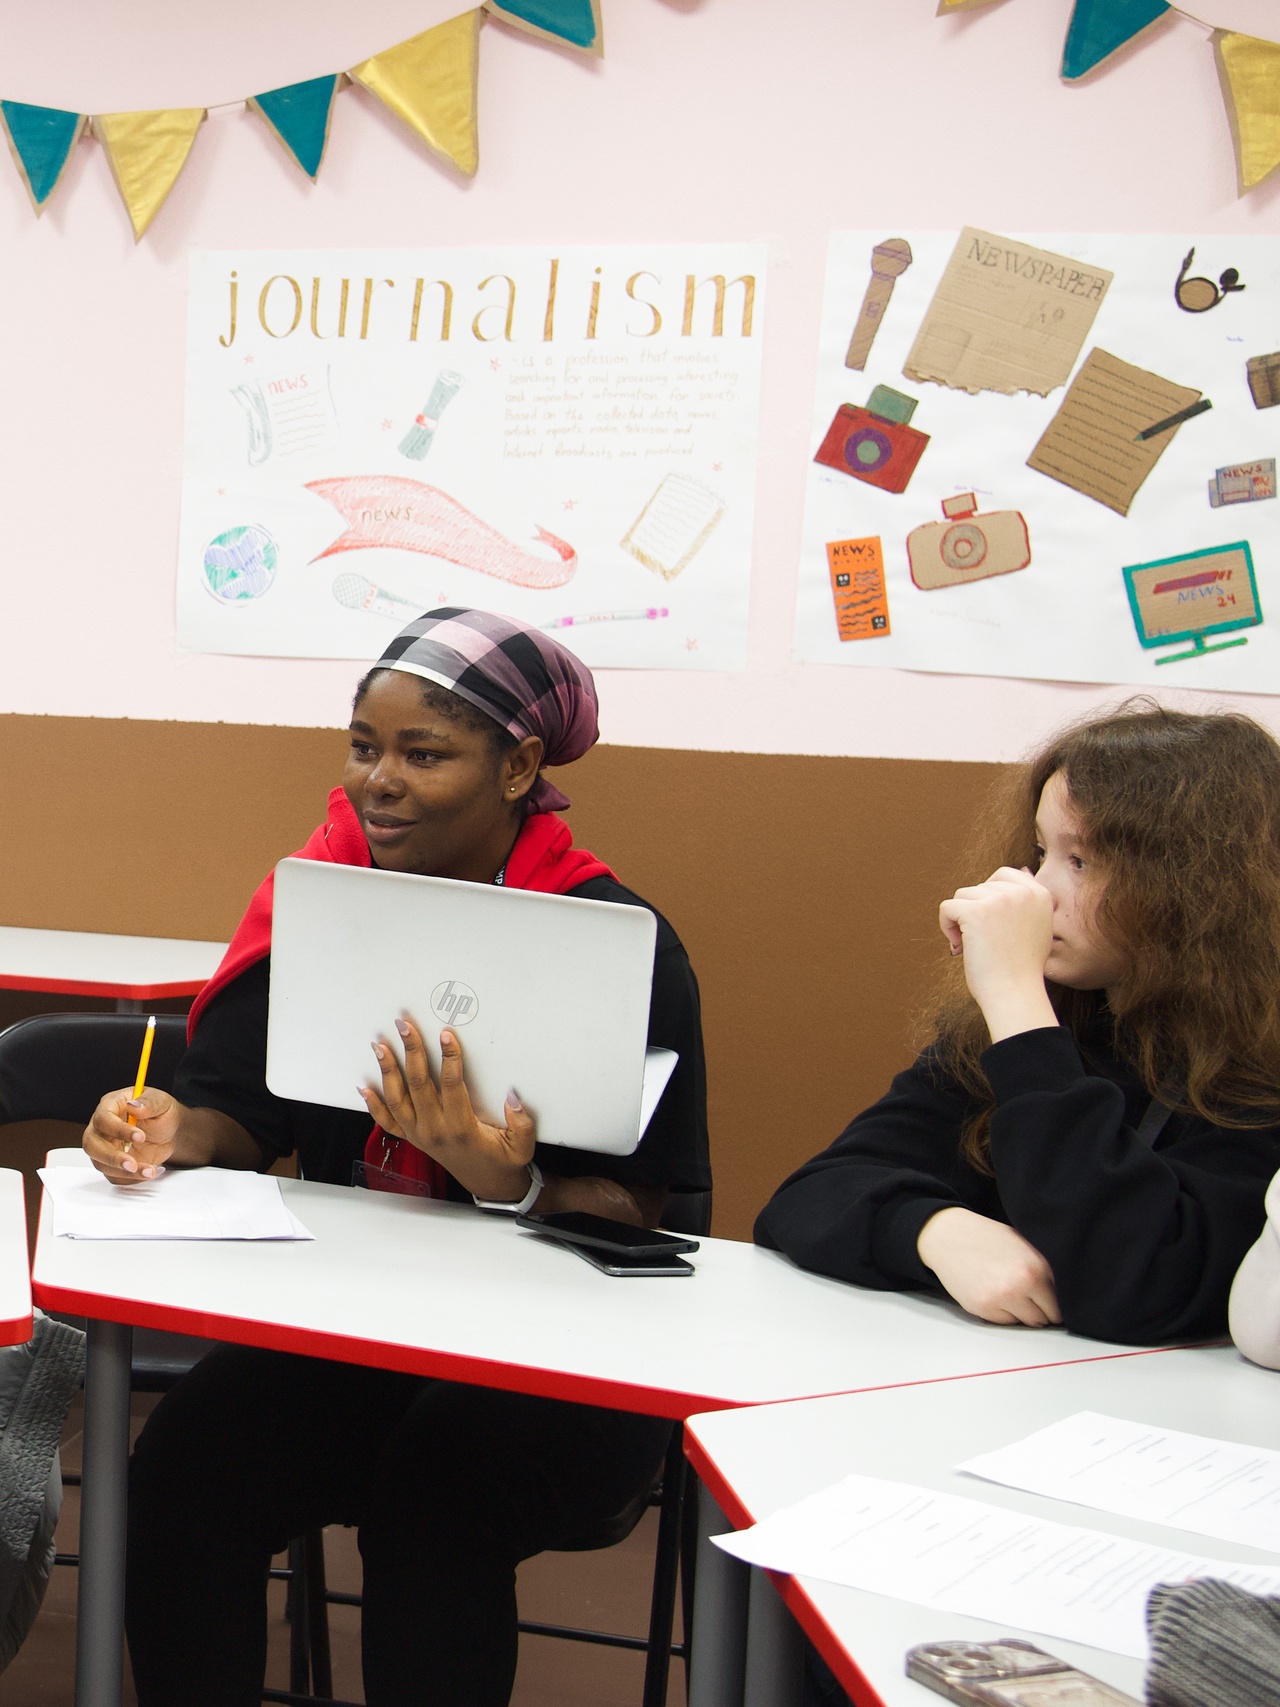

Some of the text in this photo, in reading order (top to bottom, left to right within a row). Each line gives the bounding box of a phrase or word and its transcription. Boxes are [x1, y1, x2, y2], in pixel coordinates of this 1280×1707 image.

[966, 238, 1106, 301] NEWSPAPER
[219, 258, 756, 347] journalism
[522, 356, 534, 367] is
[545, 356, 553, 366] a
[564, 348, 628, 370] profession
[640, 347, 669, 363] that
[505, 407, 537, 421] Based
[564, 408, 585, 421] the
[1222, 464, 1263, 479] NEWS
[833, 543, 875, 557] NEWS
[1177, 583, 1225, 605] NEWS
[436, 980, 474, 1026] hp
